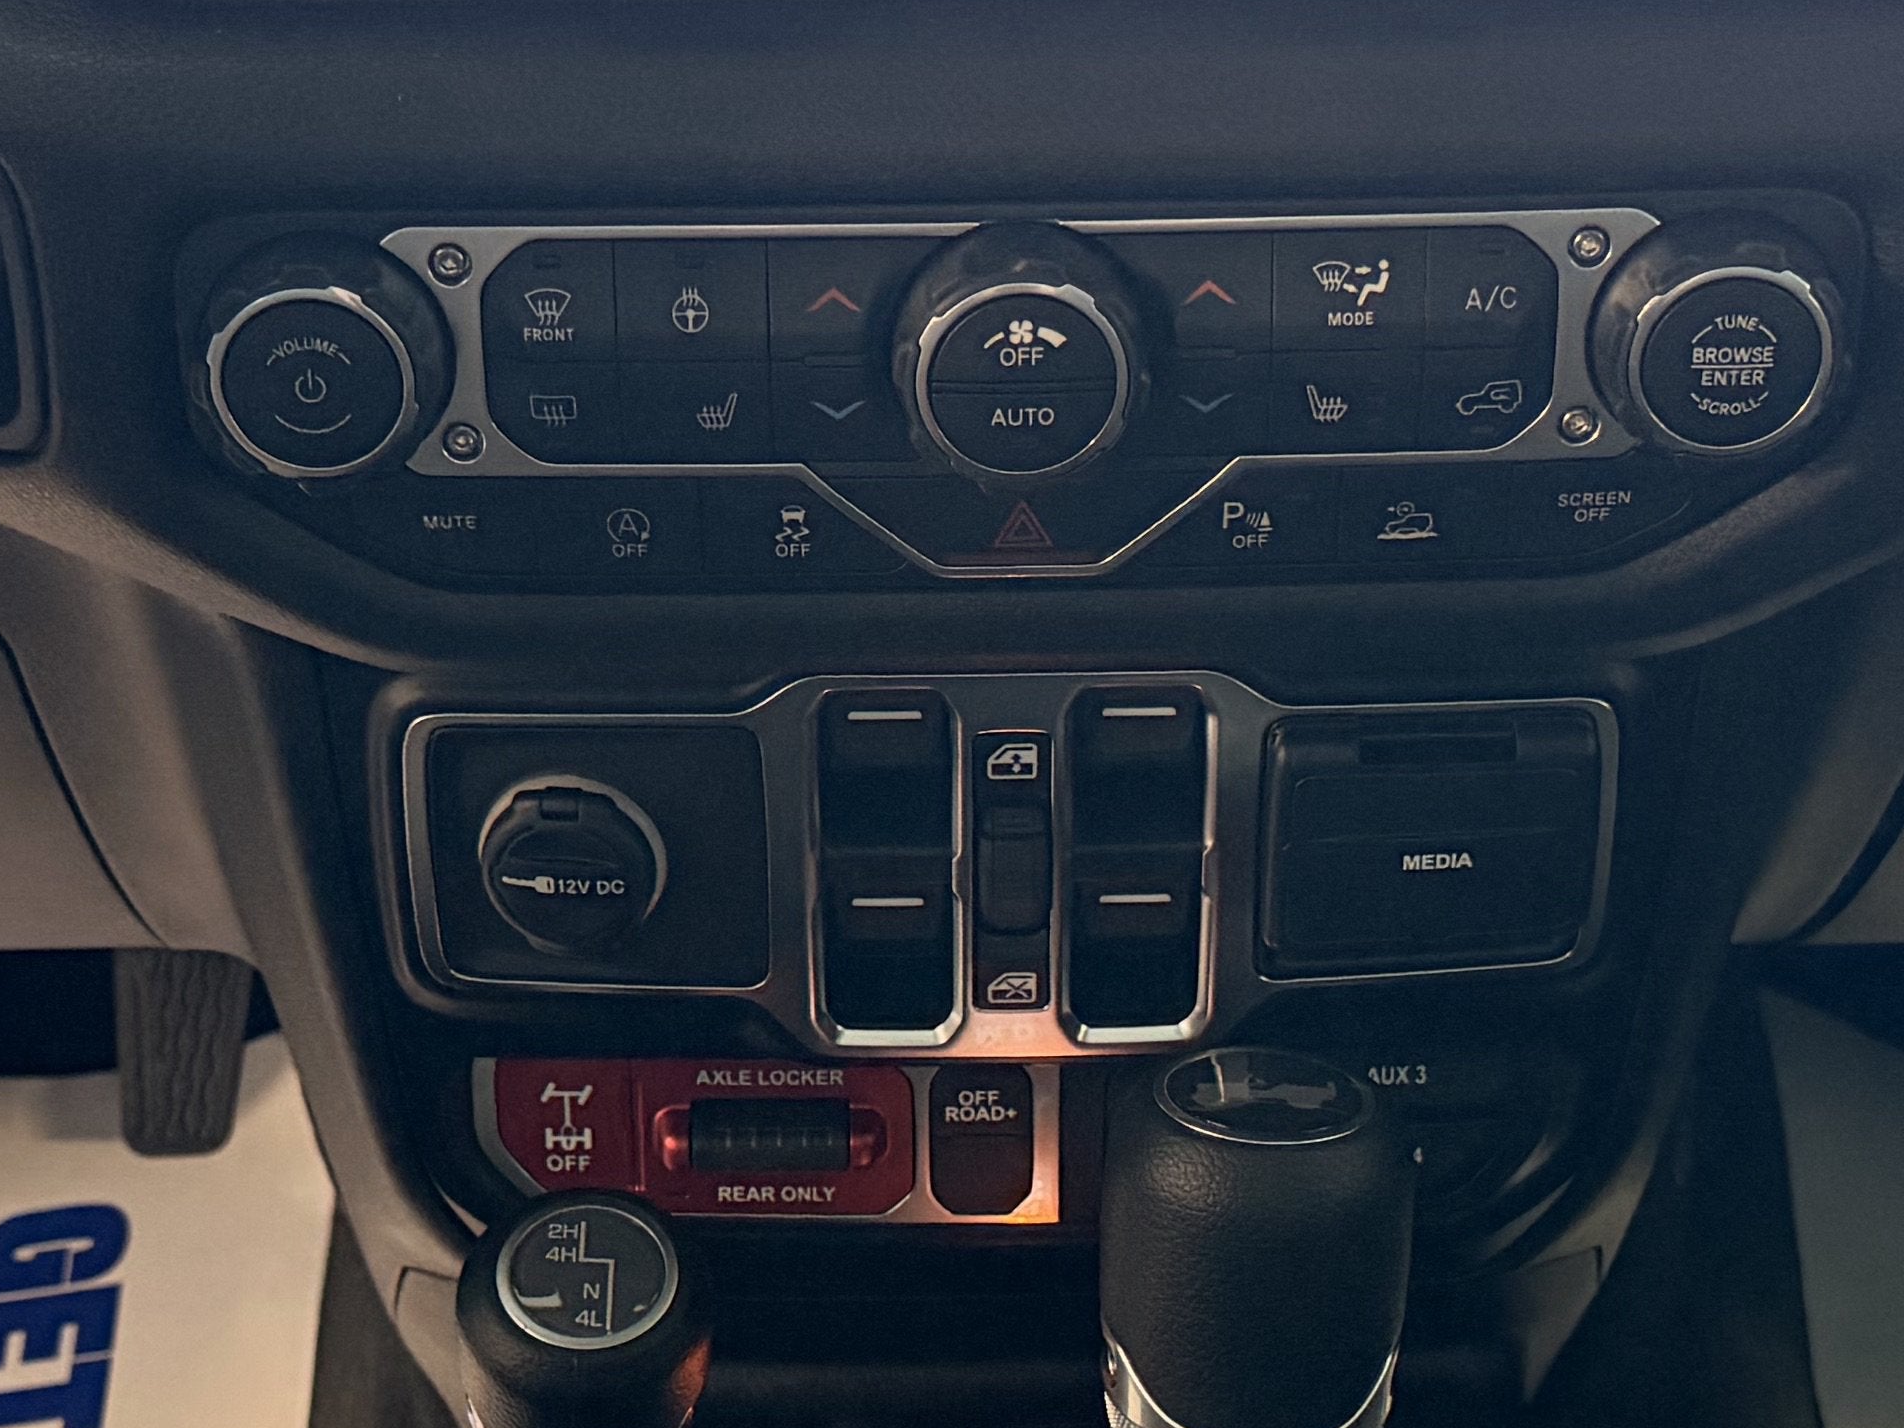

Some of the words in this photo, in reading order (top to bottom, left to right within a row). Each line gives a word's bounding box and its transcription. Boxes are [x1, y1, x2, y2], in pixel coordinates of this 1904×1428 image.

[1464, 285, 1518, 312] A/C
[1328, 310, 1375, 327] MODE
[1714, 314, 1760, 332] TUNE
[523, 327, 574, 342] FRONT
[272, 337, 340, 358] VOLUME
[1692, 346, 1775, 364] BROWSE
[1000, 347, 1044, 367] OFF
[1700, 369, 1765, 386] ENTER
[1698, 397, 1761, 416] SCROLL
[991, 407, 1055, 427] AUTO
[1558, 490, 1631, 508] SCREEN
[423, 514, 477, 531] MUTE
[1574, 507, 1611, 523] OFF
[775, 542, 810, 559] OFF
[1232, 533, 1269, 550] OFF
[612, 543, 649, 559] OFF
[1402, 852, 1473, 871] MEDIA
[557, 879, 590, 895] 12V
[596, 879, 625, 895] DC
[696, 1069, 752, 1086] AXLE
[757, 1069, 845, 1087] LOCKER
[1415, 1064, 1428, 1085] 3
[958, 1090, 999, 1107] OFF
[944, 1105, 1018, 1123] ROAD+
[546, 1154, 591, 1172] OFF
[717, 1185, 776, 1202] REAR
[780, 1185, 836, 1203] ONLY
[548, 1223, 580, 1239] 2H
[545, 1246, 577, 1263] 4H
[582, 1283, 600, 1300] N
[574, 1310, 603, 1328] 4L
